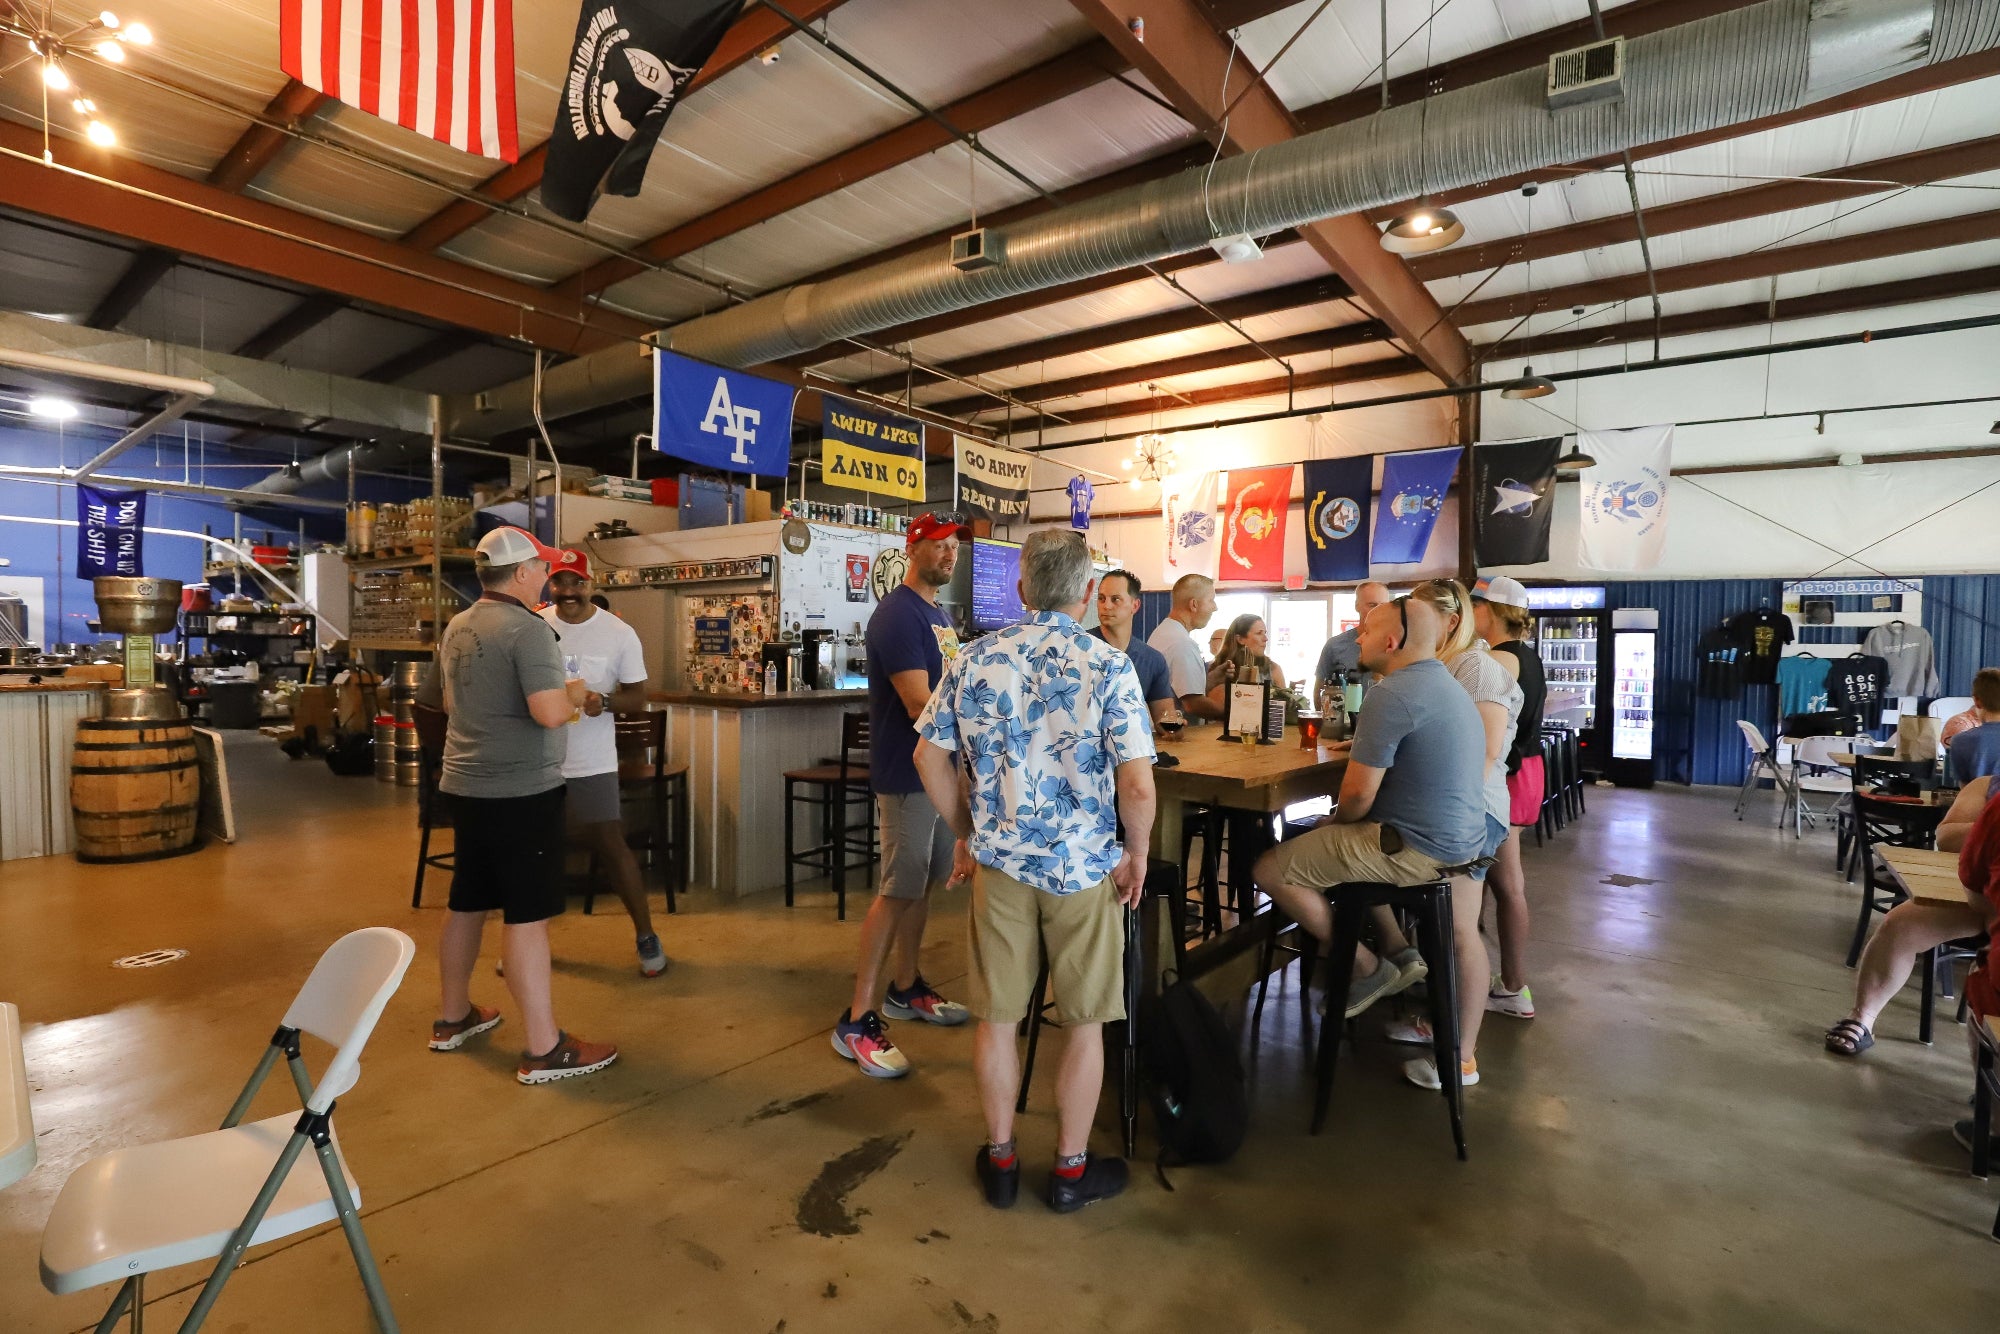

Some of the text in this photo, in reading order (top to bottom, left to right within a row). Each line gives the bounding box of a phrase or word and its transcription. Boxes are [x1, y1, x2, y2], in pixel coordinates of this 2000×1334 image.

[595, 5, 618, 32] YOU
[575, 37, 595, 71] NOT
[568, 64, 590, 141] FORGOTTEN
[700, 376, 760, 464] AF
[831, 411, 919, 446] BEAT ARMY
[830, 454, 918, 489] GO NAVY
[965, 449, 1027, 479] GO ARMY
[960, 485, 1029, 515] BEAT NAV
[87, 504, 107, 566] THE SHIP
[117, 533, 135, 558] GIVE
[116, 560, 135, 574] UP
[1571, 592, 1597, 609] go
[1845, 673, 1876, 685] dec
[1848, 692, 1869, 702] er
